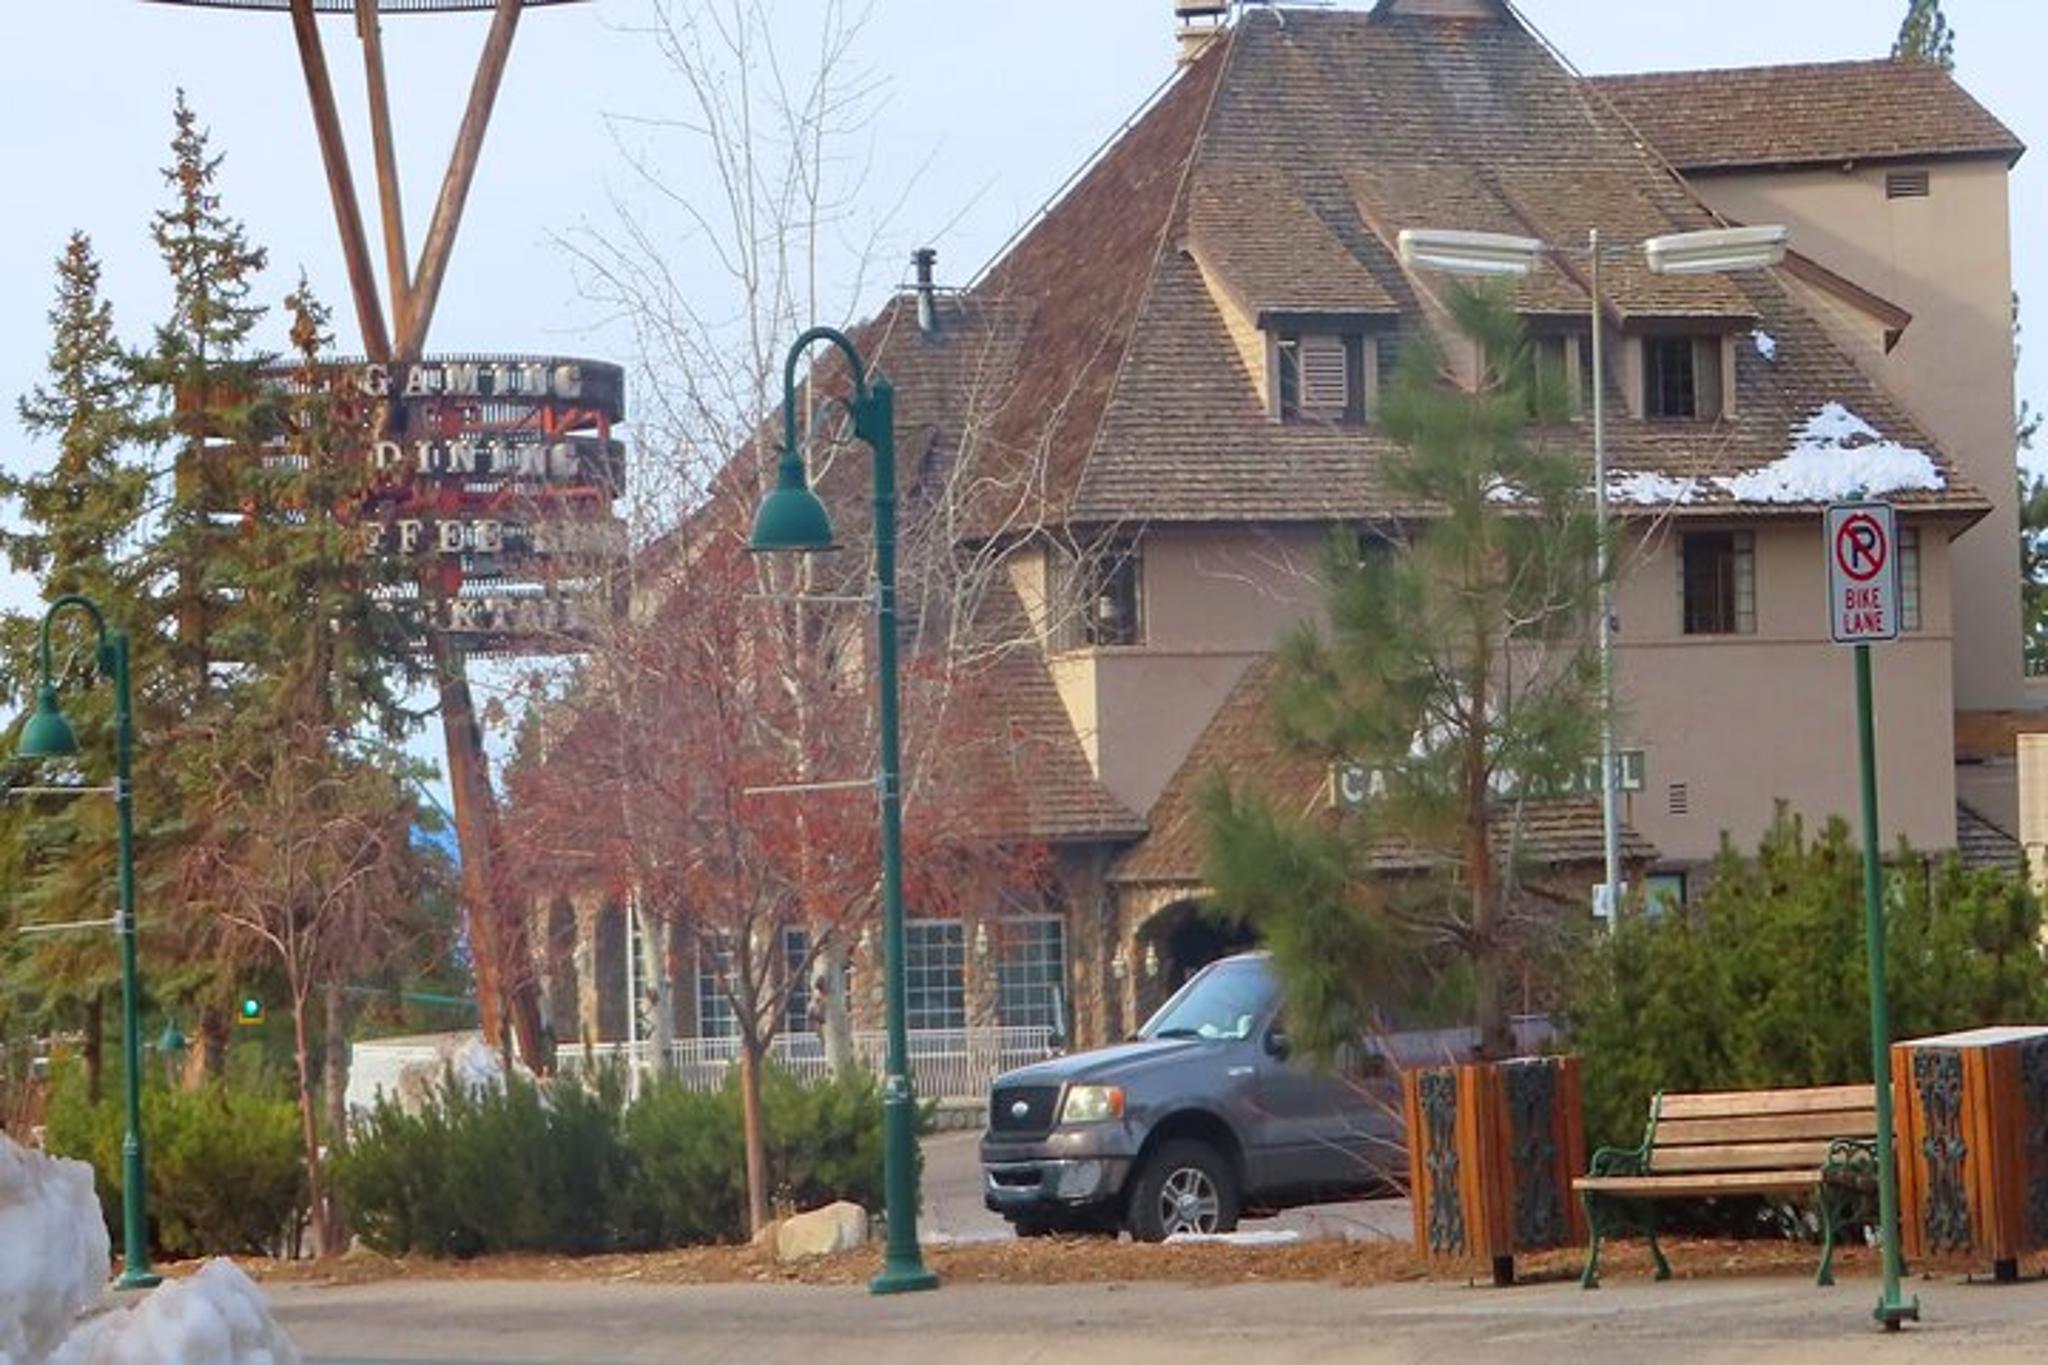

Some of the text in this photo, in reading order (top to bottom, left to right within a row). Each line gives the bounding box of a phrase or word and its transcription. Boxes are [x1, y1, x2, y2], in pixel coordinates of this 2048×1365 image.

[359, 362, 582, 397] GAMING
[374, 440, 580, 474] DINING
[1845, 588, 1881, 610] BIKE
[1843, 611, 1885, 634] LANE
